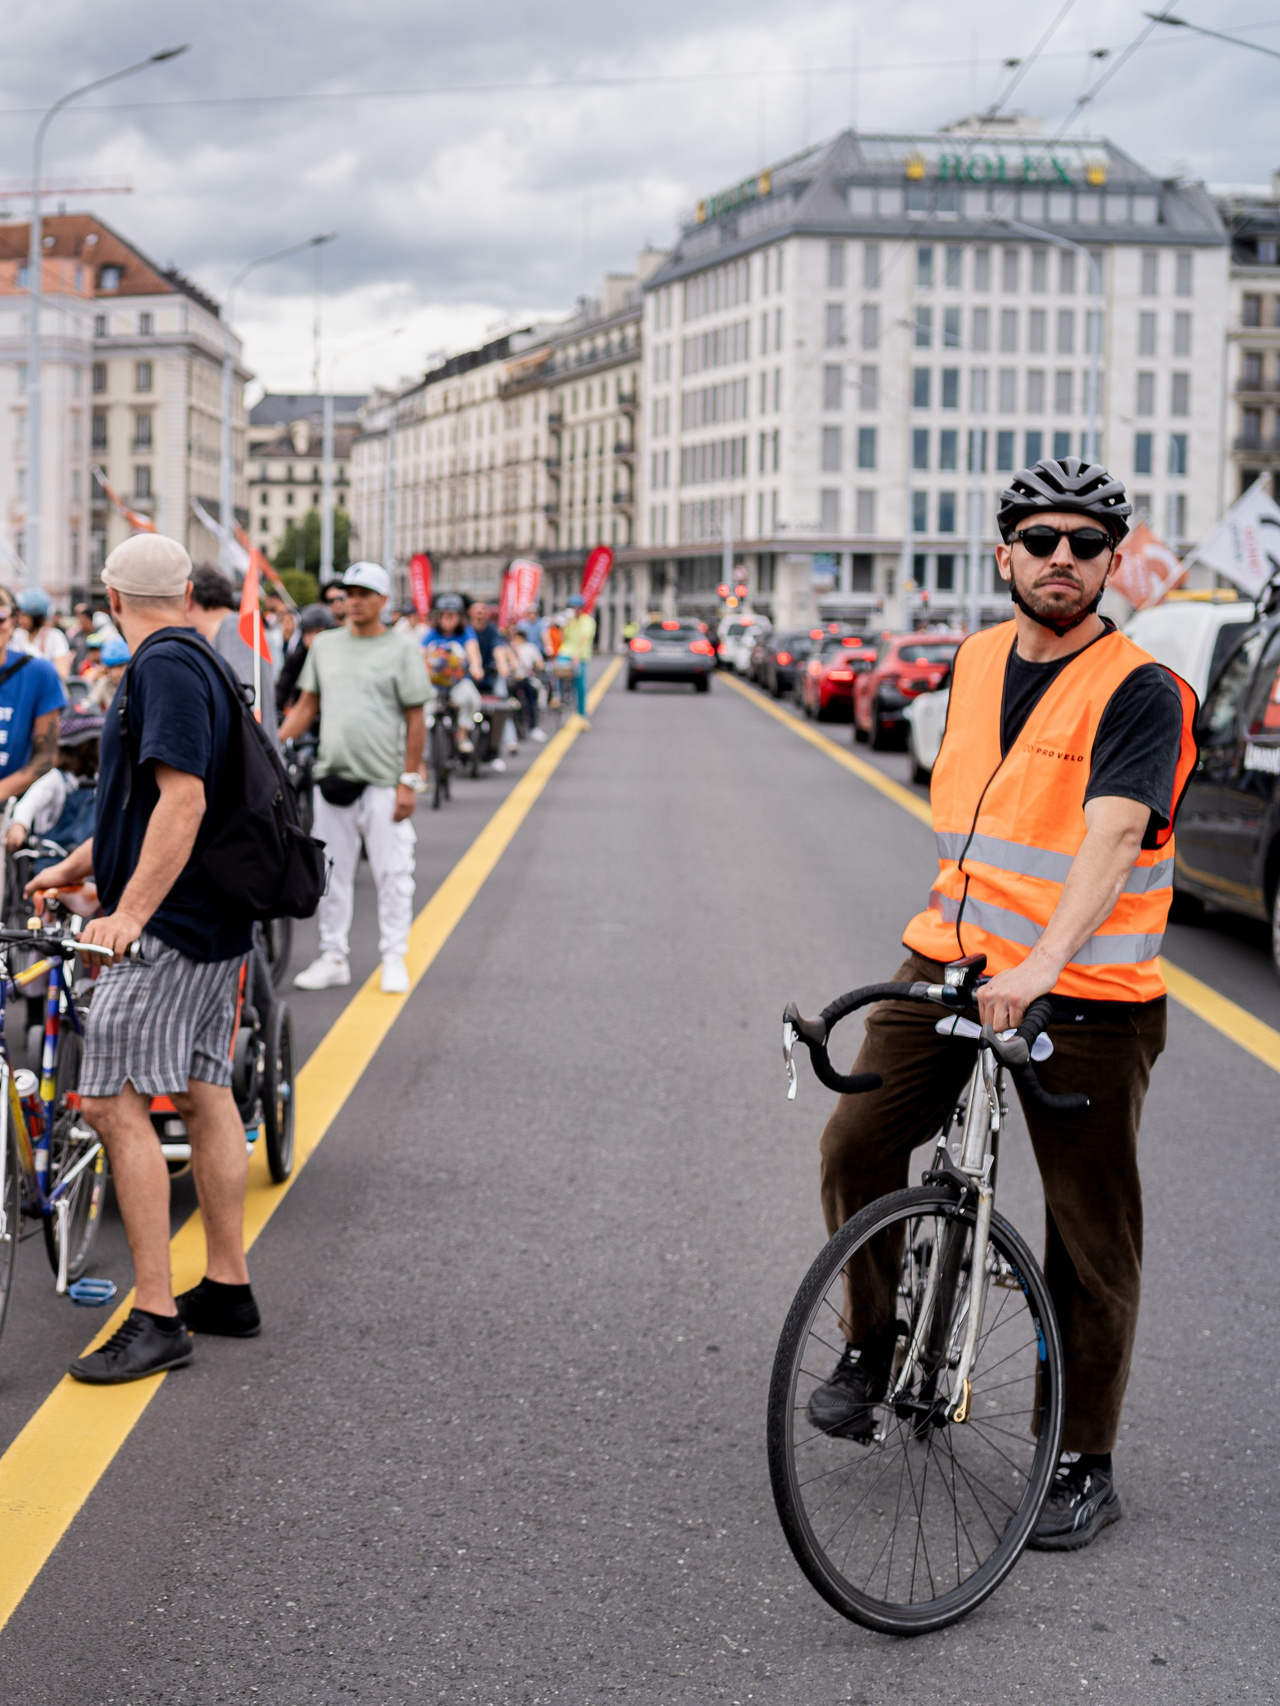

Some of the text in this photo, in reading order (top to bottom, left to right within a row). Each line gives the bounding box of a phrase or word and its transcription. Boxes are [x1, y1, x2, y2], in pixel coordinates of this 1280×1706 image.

[938, 153, 1073, 184] ROLEX
[1036, 747, 1084, 762] PRO VELO
